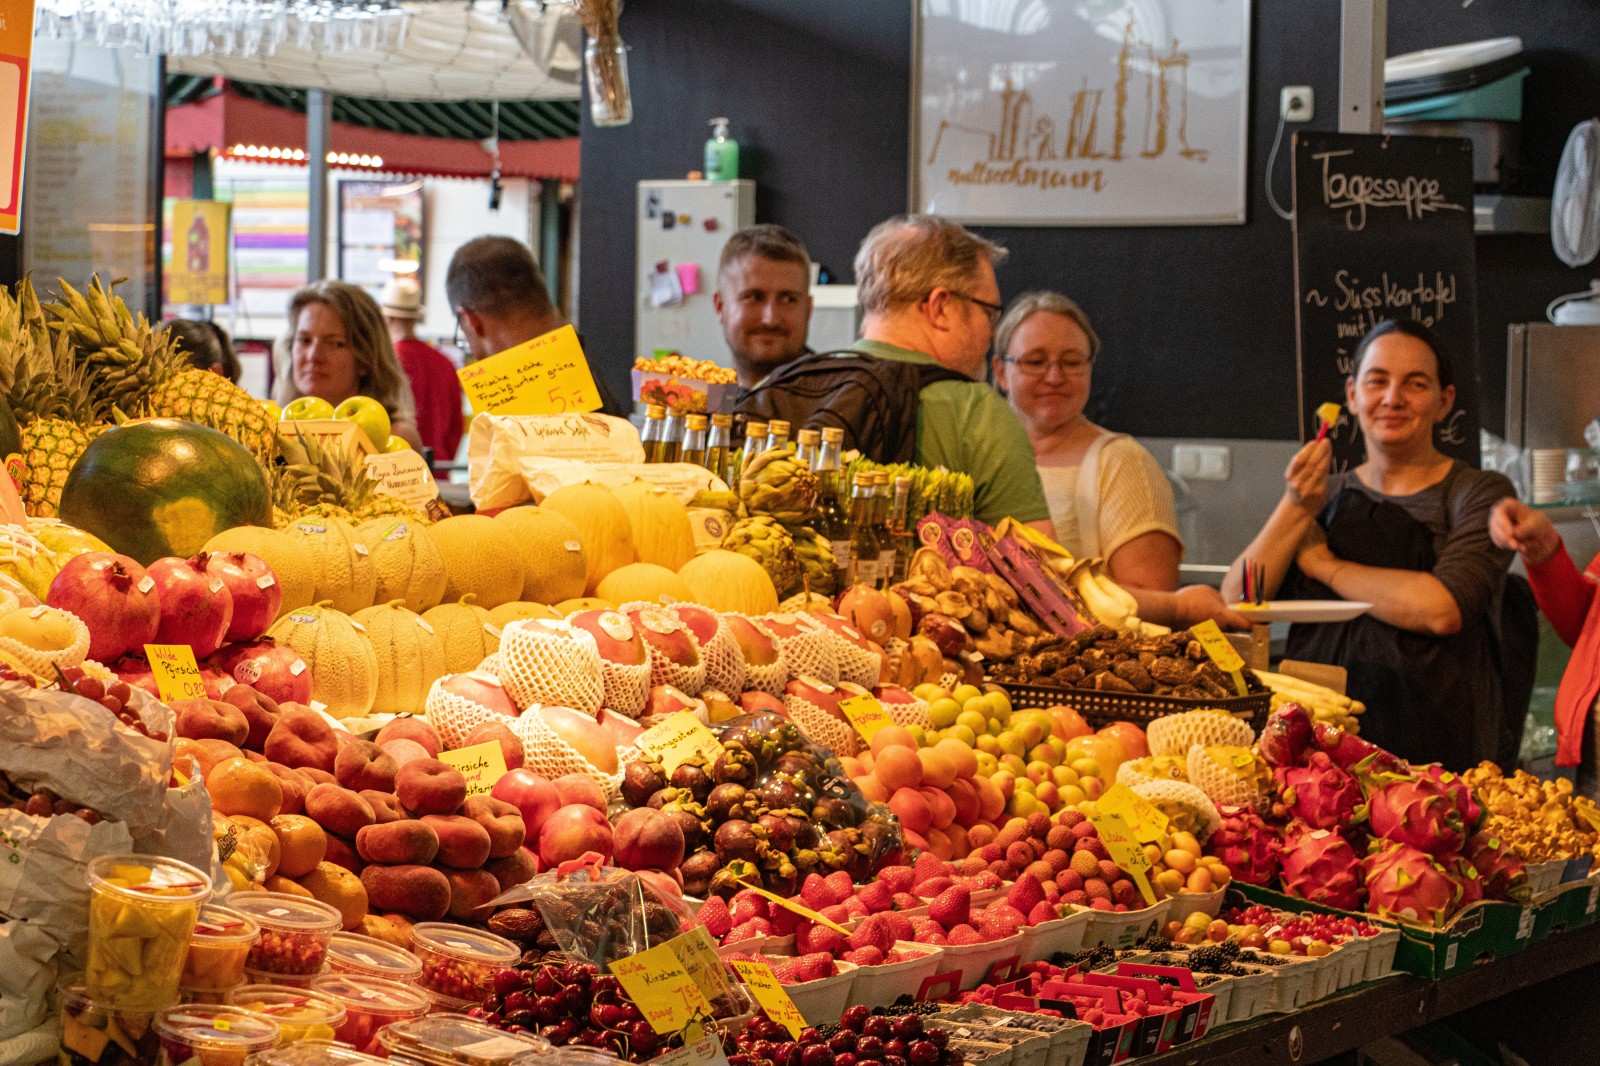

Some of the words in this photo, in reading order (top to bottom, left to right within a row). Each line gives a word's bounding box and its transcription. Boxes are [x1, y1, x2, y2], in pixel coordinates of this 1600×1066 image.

[1312, 150, 1445, 231] Tagessuppe
[1337, 313, 1367, 338] mit
[472, 374, 510, 391] Frische
[476, 373, 540, 401] Frankfurter
[547, 361, 577, 379] grüne
[153, 647, 178, 661] Wilde
[648, 726, 700, 754] Mangosteen
[447, 755, 489, 772] irsiche
[642, 968, 685, 987] Kirschen
